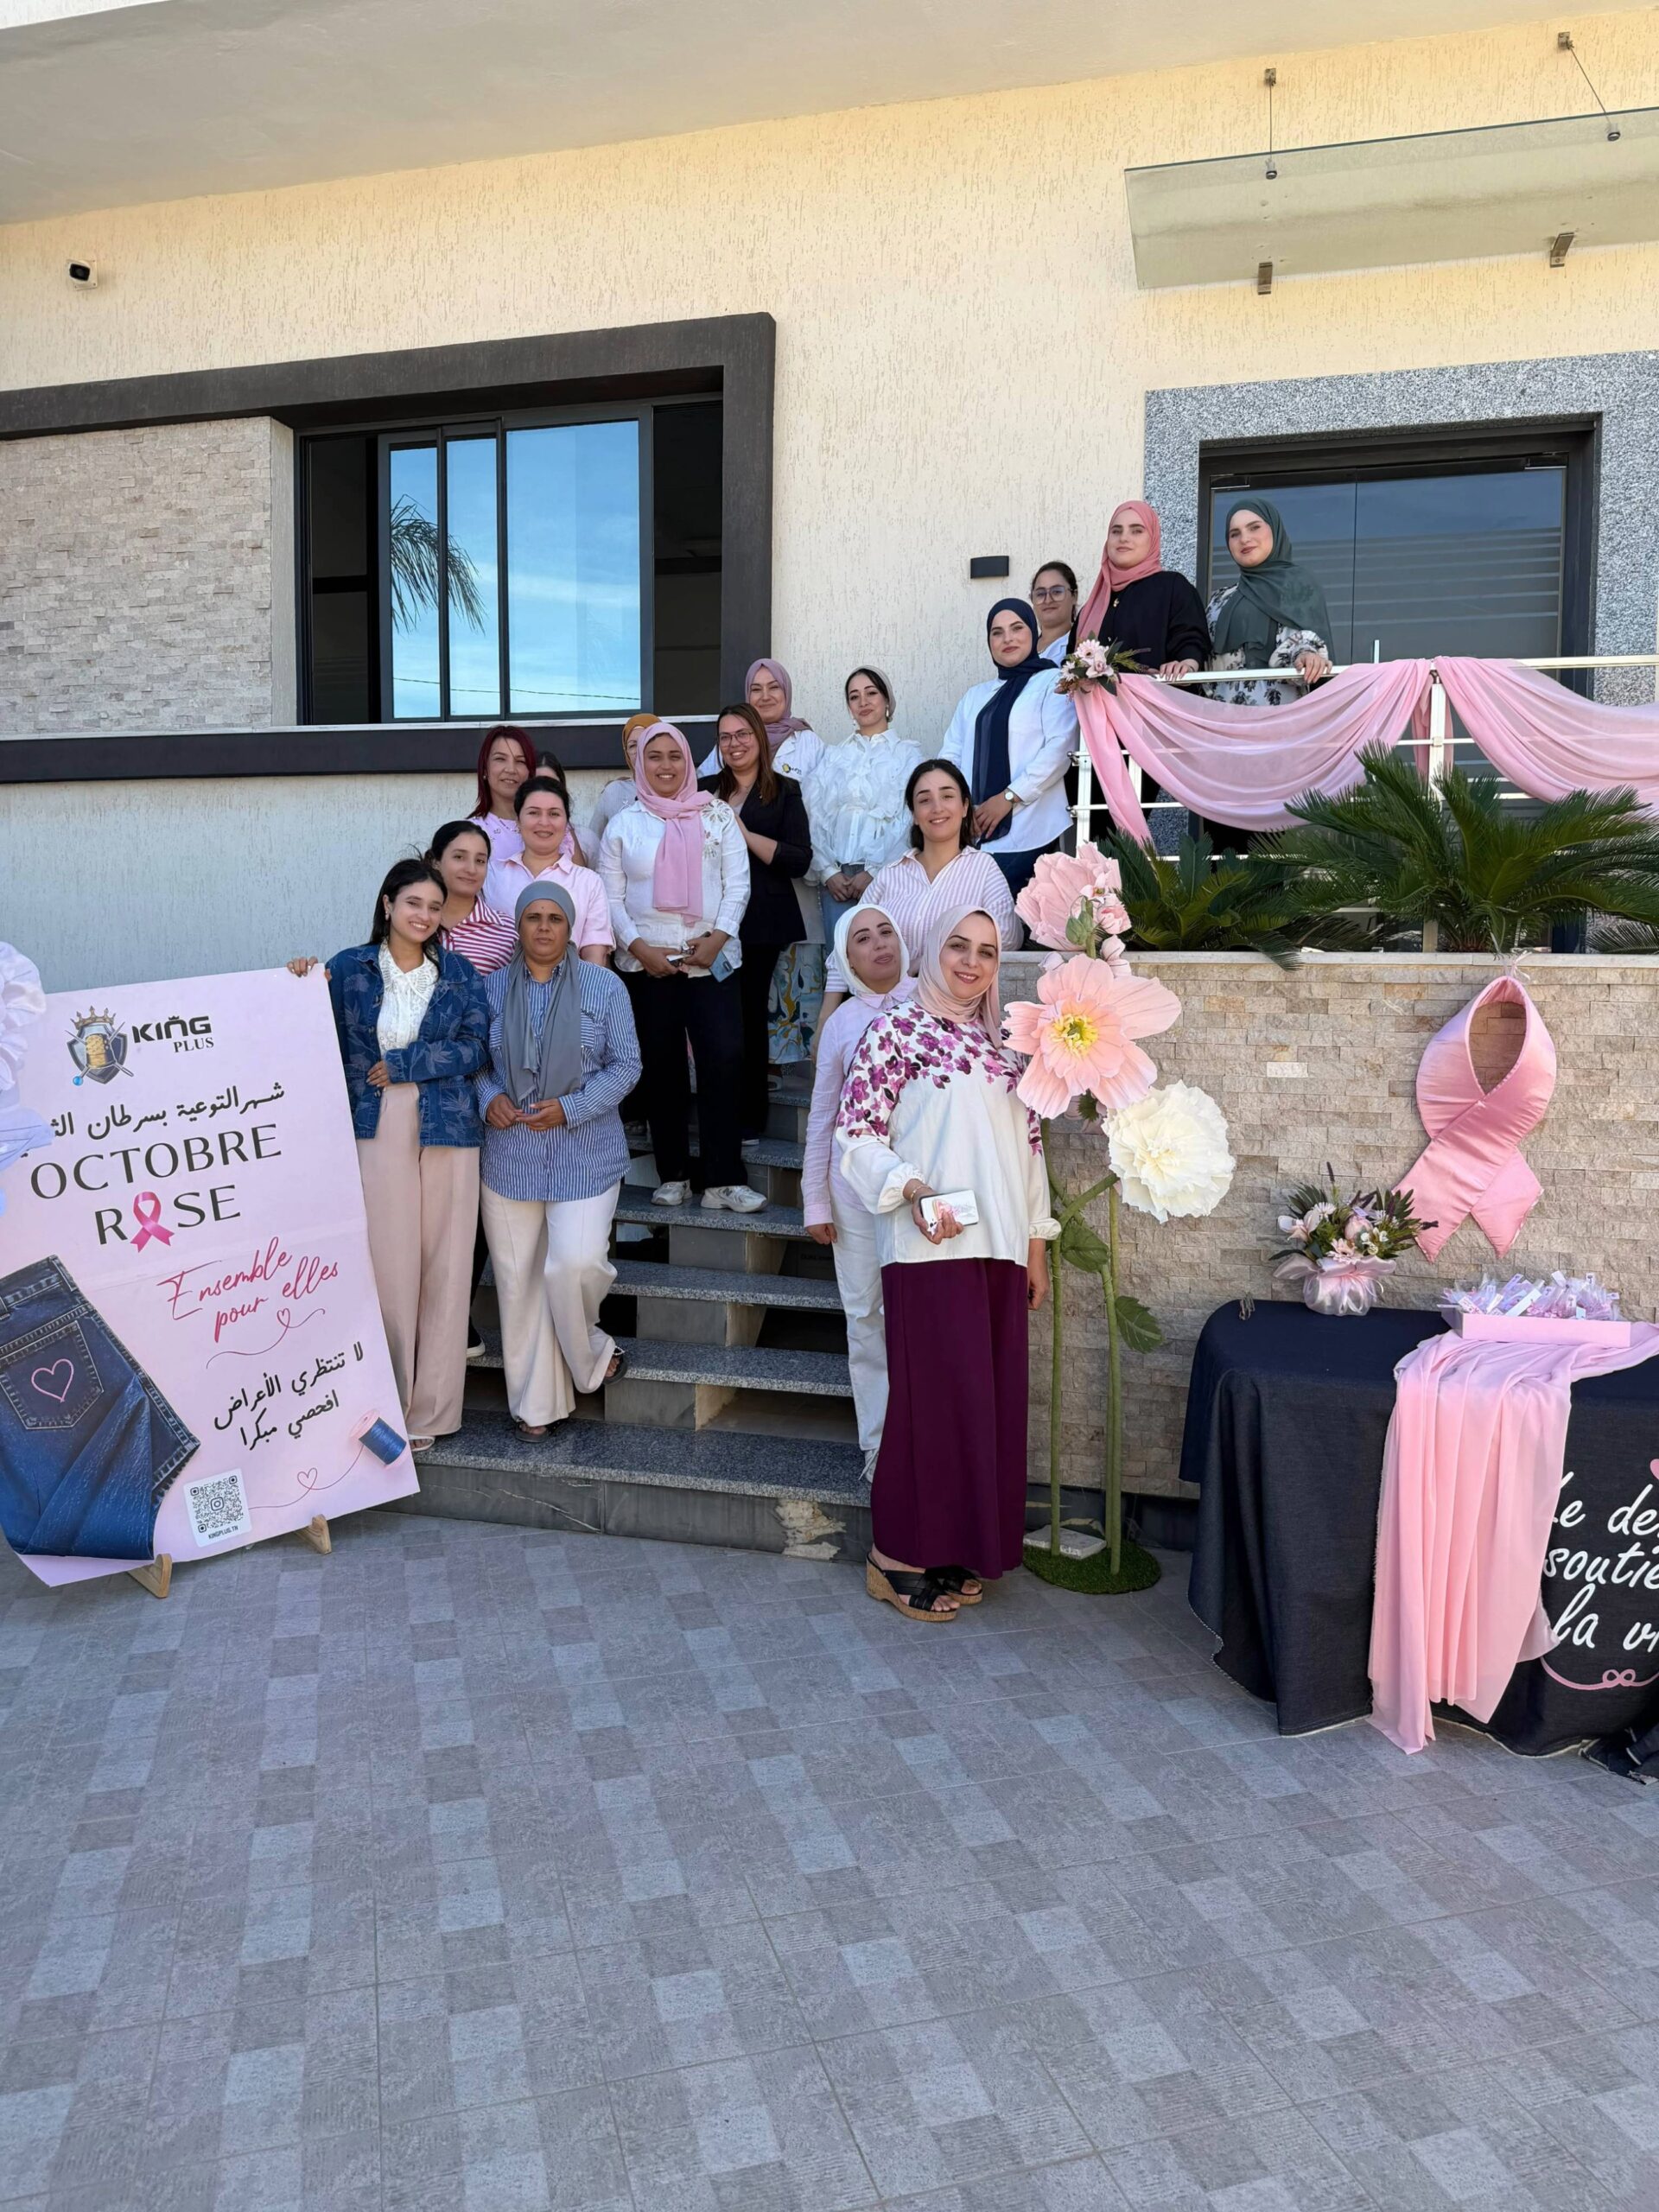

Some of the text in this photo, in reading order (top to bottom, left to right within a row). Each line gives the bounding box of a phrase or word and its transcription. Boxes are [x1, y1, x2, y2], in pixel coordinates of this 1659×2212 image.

[174, 1037, 214, 1053] PLUS
[87, 1104, 167, 1140] بسرطان
[30, 1123, 282, 1199] OCTOBRE
[156, 1236, 293, 1320] Ensemble
[214, 1255, 339, 1343] pour elles
[353, 1341, 364, 1362] لا
[208, 1525, 238, 1540] KINGPLUS.TN
